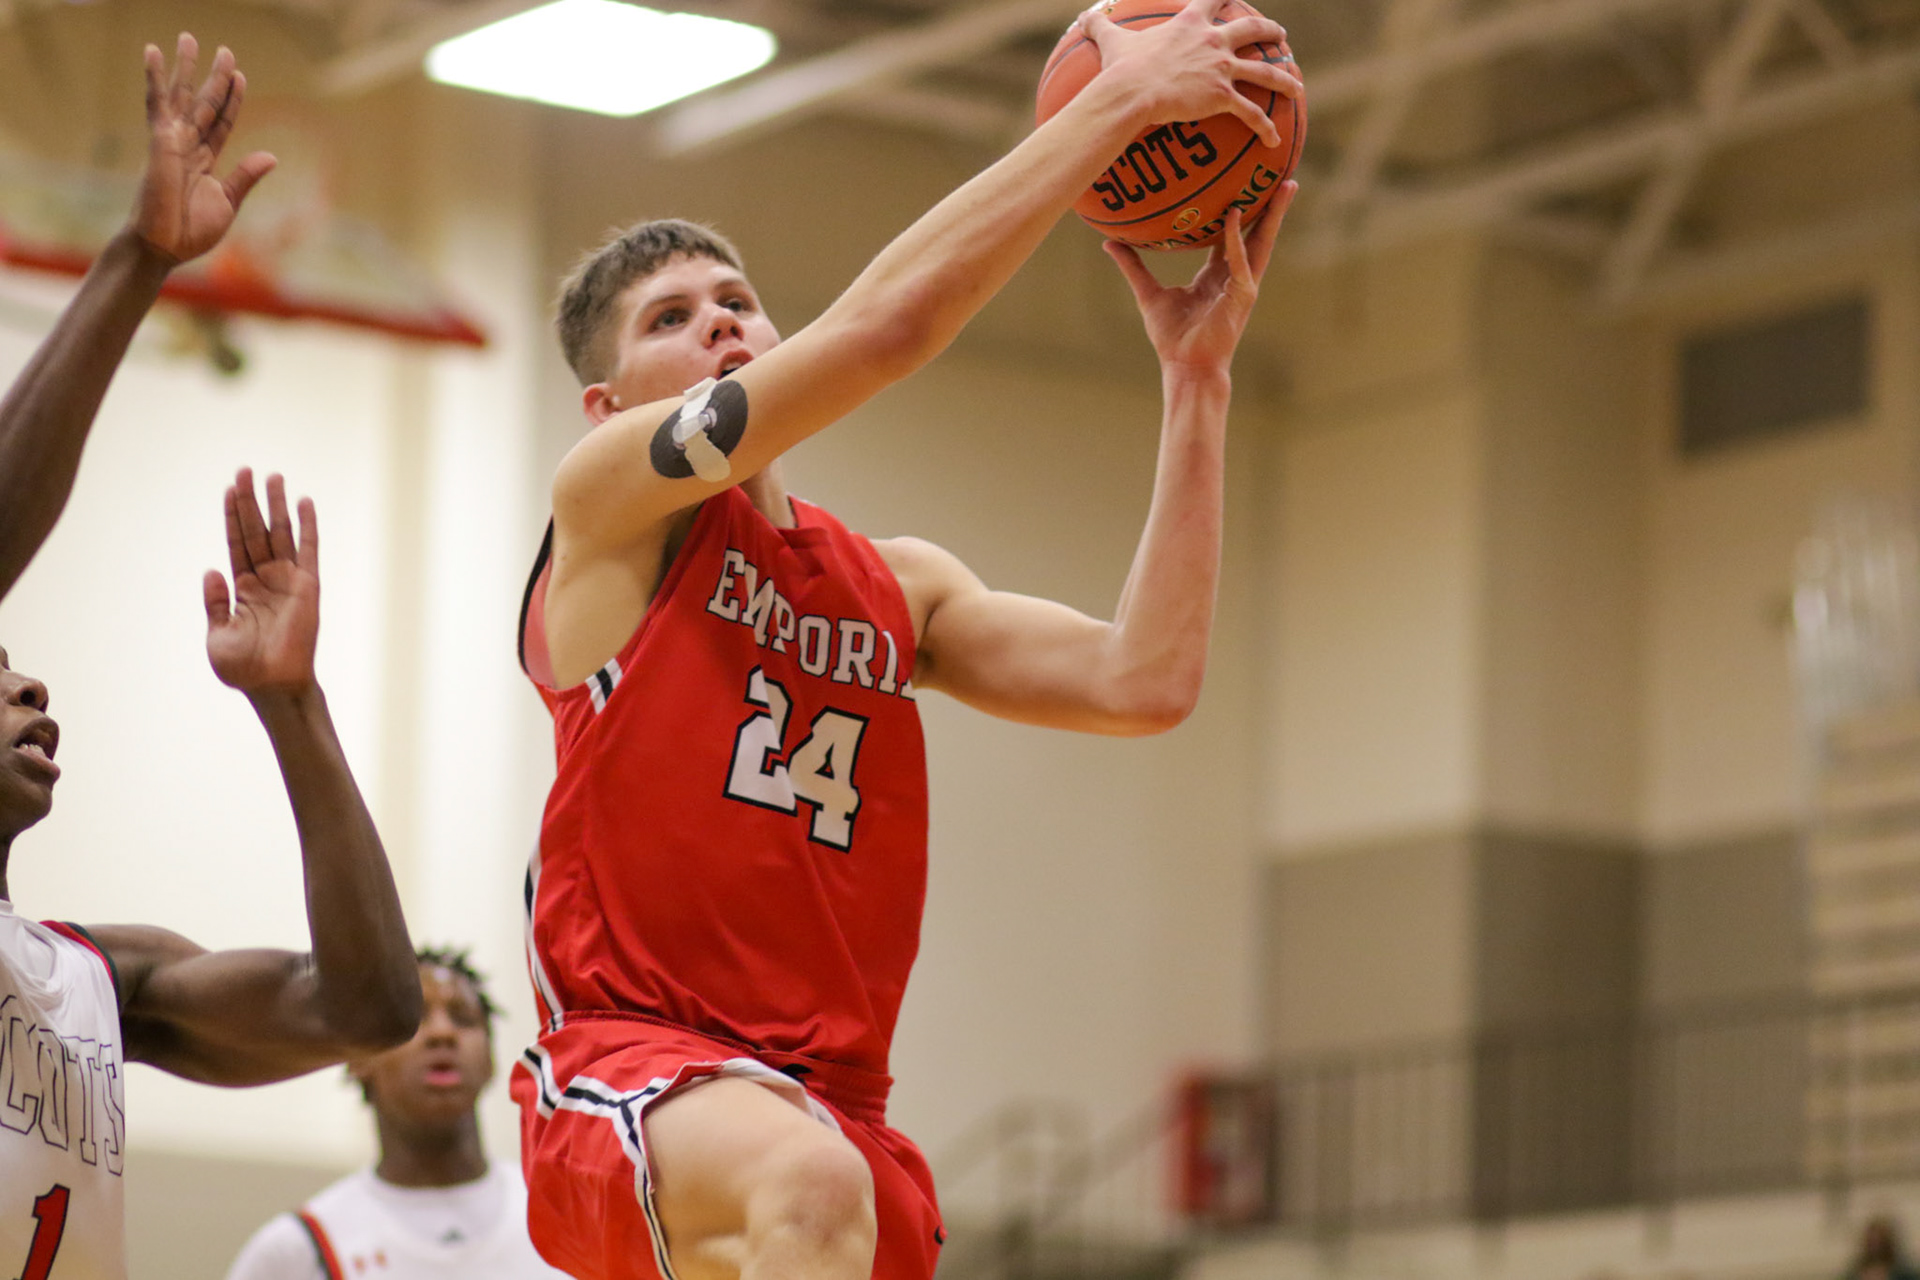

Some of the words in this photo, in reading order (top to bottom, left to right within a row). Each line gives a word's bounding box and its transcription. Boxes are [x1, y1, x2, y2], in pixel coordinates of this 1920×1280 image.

[1092, 120, 1218, 212] SCOTS
[705, 547, 915, 701] EMPORI
[722, 664, 870, 854] 24
[12, 1183, 71, 1280] 1
